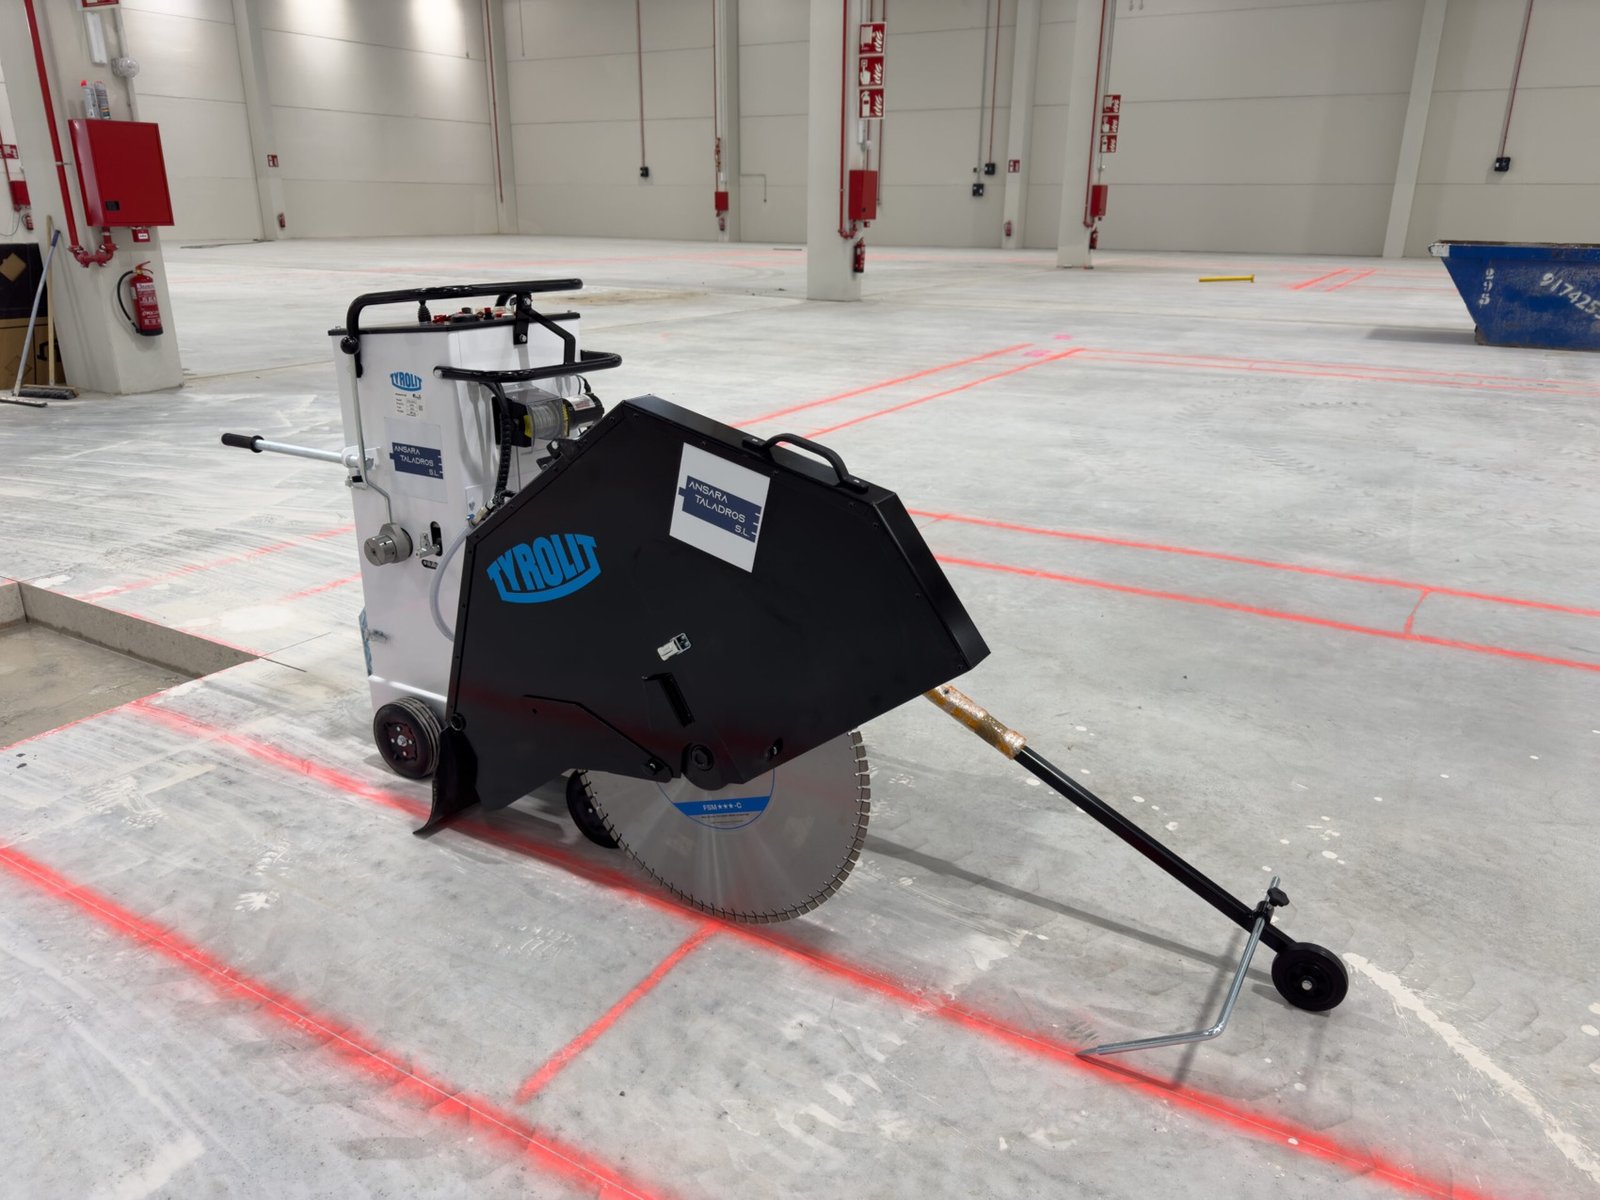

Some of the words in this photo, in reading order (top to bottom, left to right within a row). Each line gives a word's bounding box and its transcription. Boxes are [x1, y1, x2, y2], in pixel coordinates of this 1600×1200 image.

[1540, 272, 1600, 319] 917425
[390, 371, 422, 391] TYROLIT
[394, 445, 421, 456] ANSARA
[400, 454, 434, 467] TALADROS
[688, 481, 728, 504] ANSARA
[694, 494, 746, 523] TALADROS
[486, 533, 602, 604] TYROLIT
